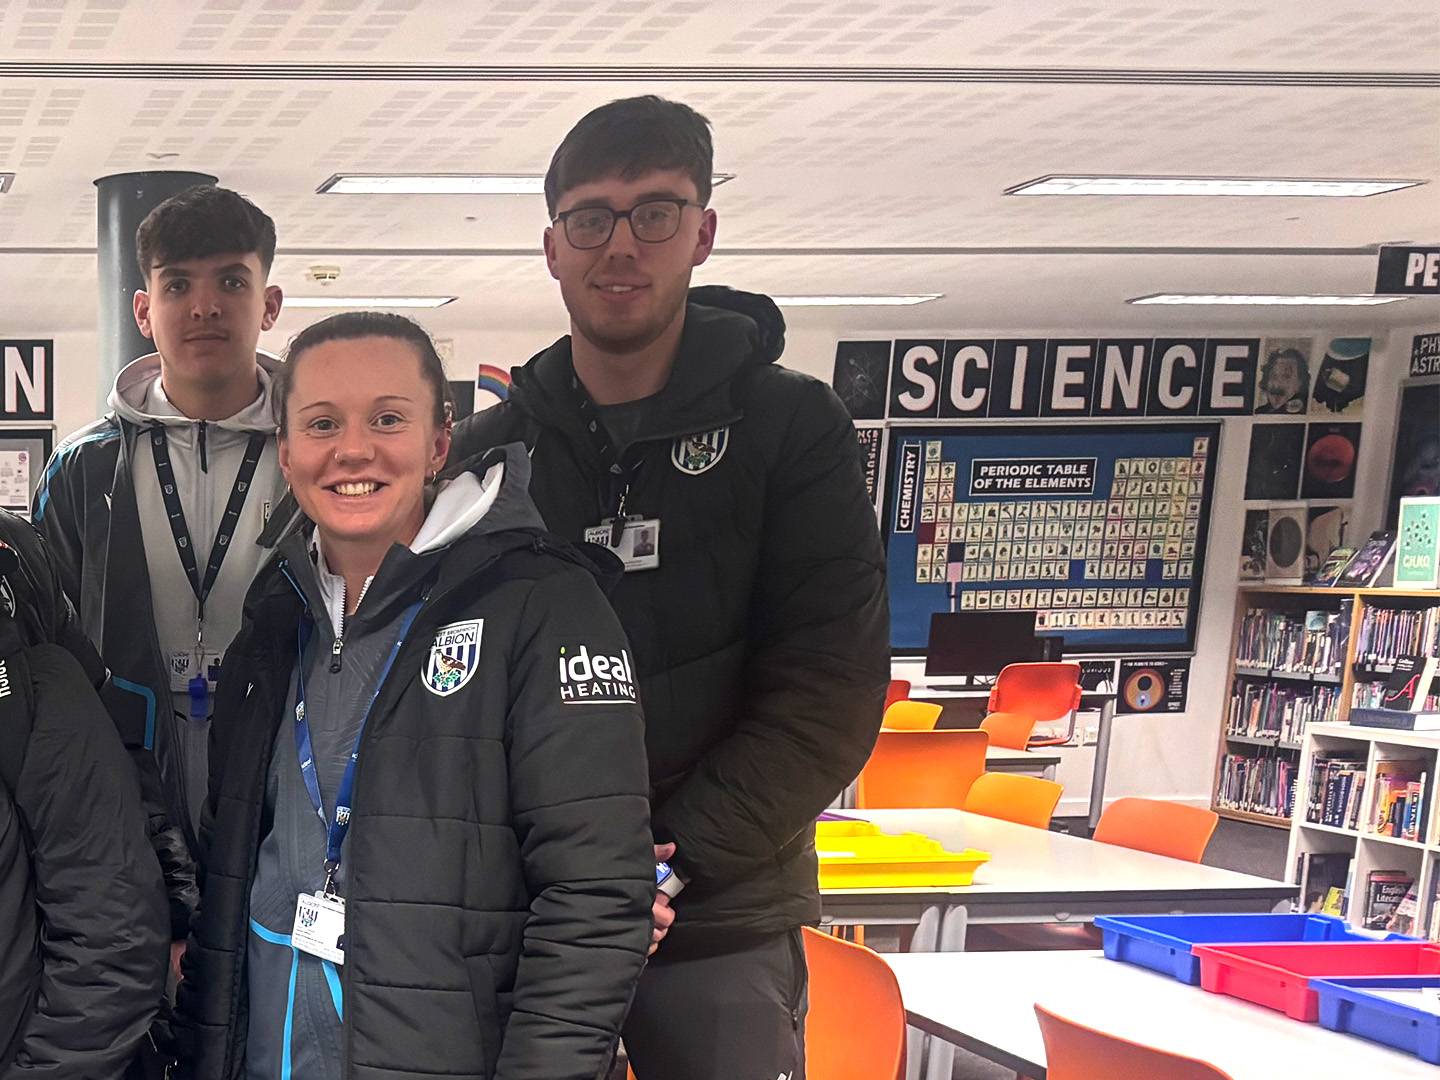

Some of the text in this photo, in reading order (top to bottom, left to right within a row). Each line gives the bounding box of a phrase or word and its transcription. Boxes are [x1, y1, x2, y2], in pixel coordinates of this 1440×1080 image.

[897, 344, 1251, 413] SCIENCE
[979, 463, 1088, 477] PERIODIC TABLE
[899, 449, 917, 529] CHEMISTRY
[973, 476, 1092, 490] OF THE ELEMENTS
[432, 631, 474, 648] ALBION
[559, 645, 633, 684] ideal
[560, 682, 636, 699] HEATING
